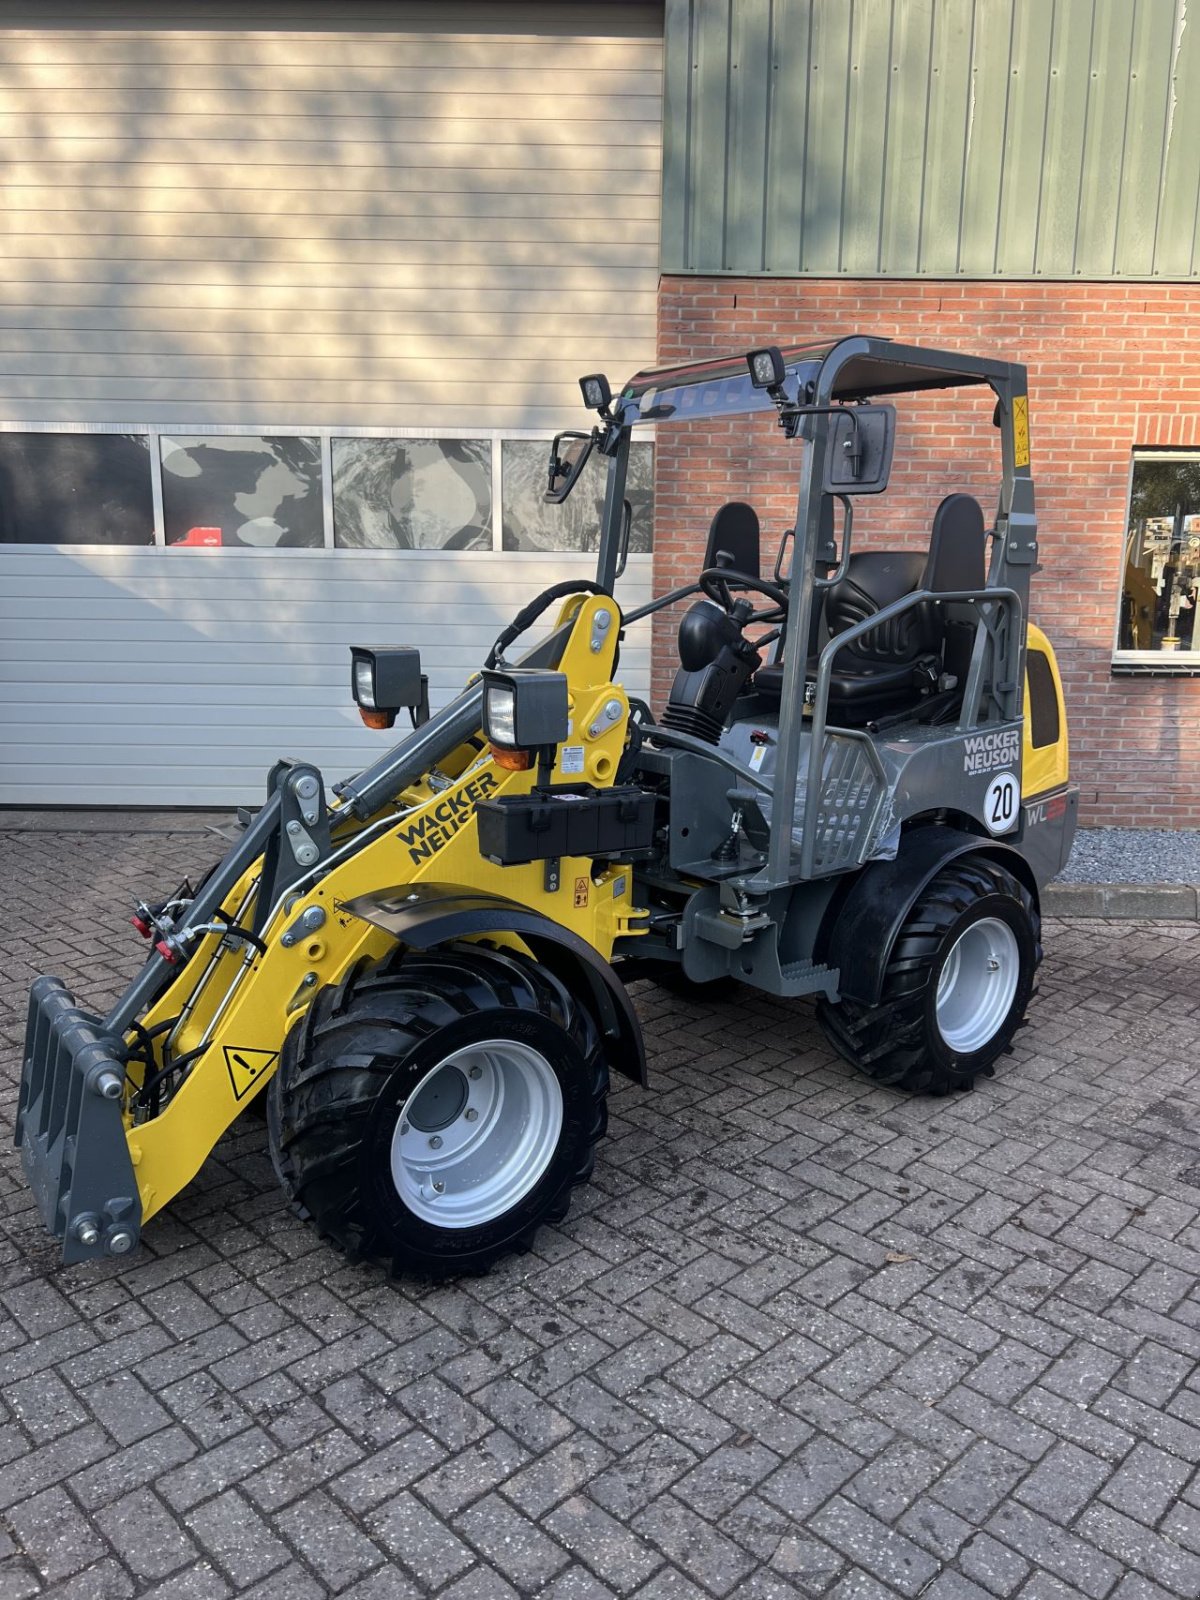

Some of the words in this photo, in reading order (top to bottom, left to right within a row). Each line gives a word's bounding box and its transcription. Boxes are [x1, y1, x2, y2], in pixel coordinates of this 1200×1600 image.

[964, 730, 1020, 755] WACKER
[964, 745, 1020, 772] NEUSON
[396, 771, 500, 846] WACKER
[991, 782, 1013, 823] 20
